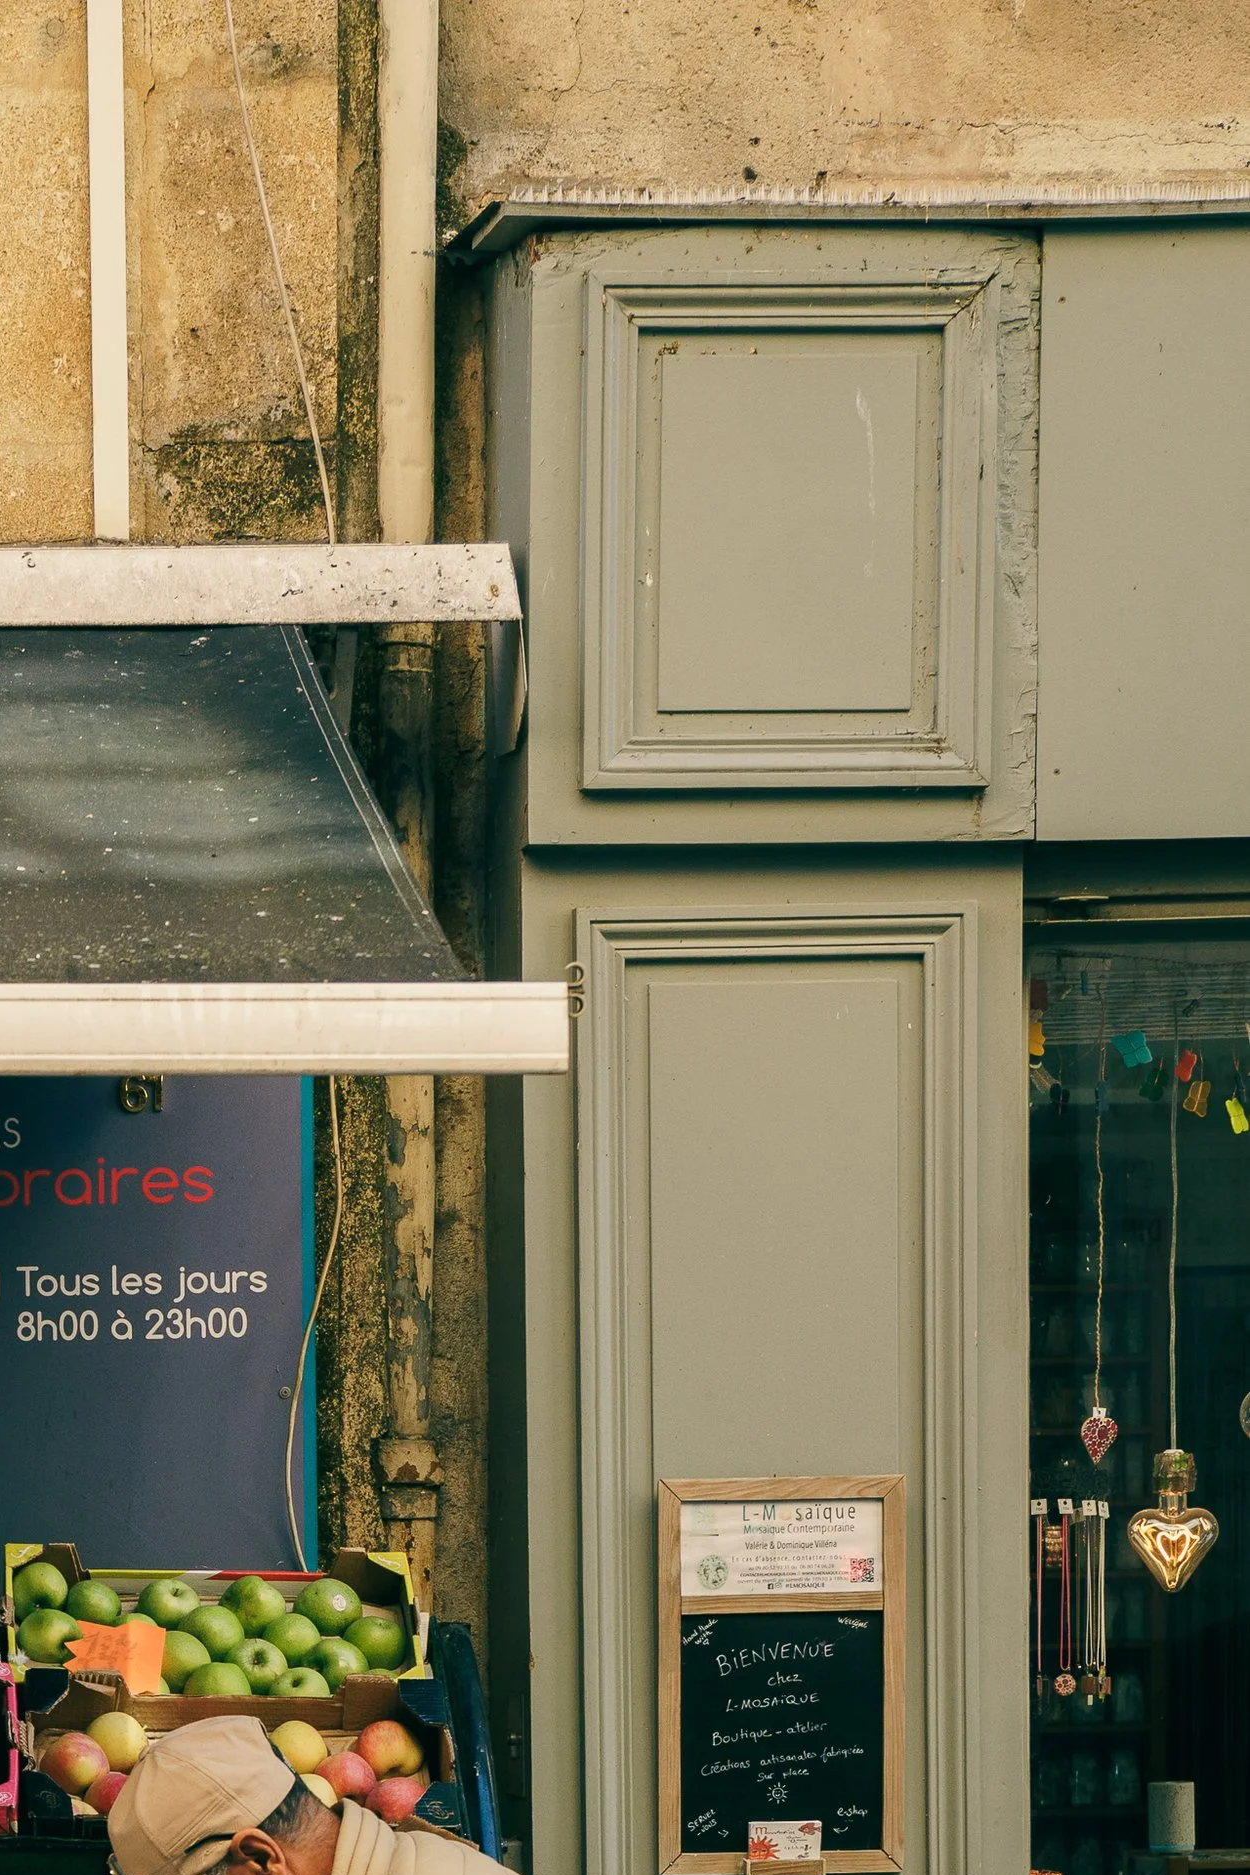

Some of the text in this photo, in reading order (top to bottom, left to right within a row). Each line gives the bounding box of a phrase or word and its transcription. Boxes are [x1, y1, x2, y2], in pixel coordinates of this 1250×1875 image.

[120, 1074, 164, 1113] 61
[16, 1264, 269, 1304] Tous les jours
[16, 1307, 248, 1343] 8h00 à 23h00
[787, 1523, 855, 1536] Contemporaine
[745, 1541, 768, 1551] Valérie
[769, 1541, 775, 1550] &
[776, 1540, 813, 1552] Dominique
[767, 1671, 803, 1687] chez
[712, 1727, 772, 1747] Boutique
[786, 1720, 828, 1736] atelier
[760, 1750, 818, 1768] artisanales
[783, 1768, 811, 1781] place
